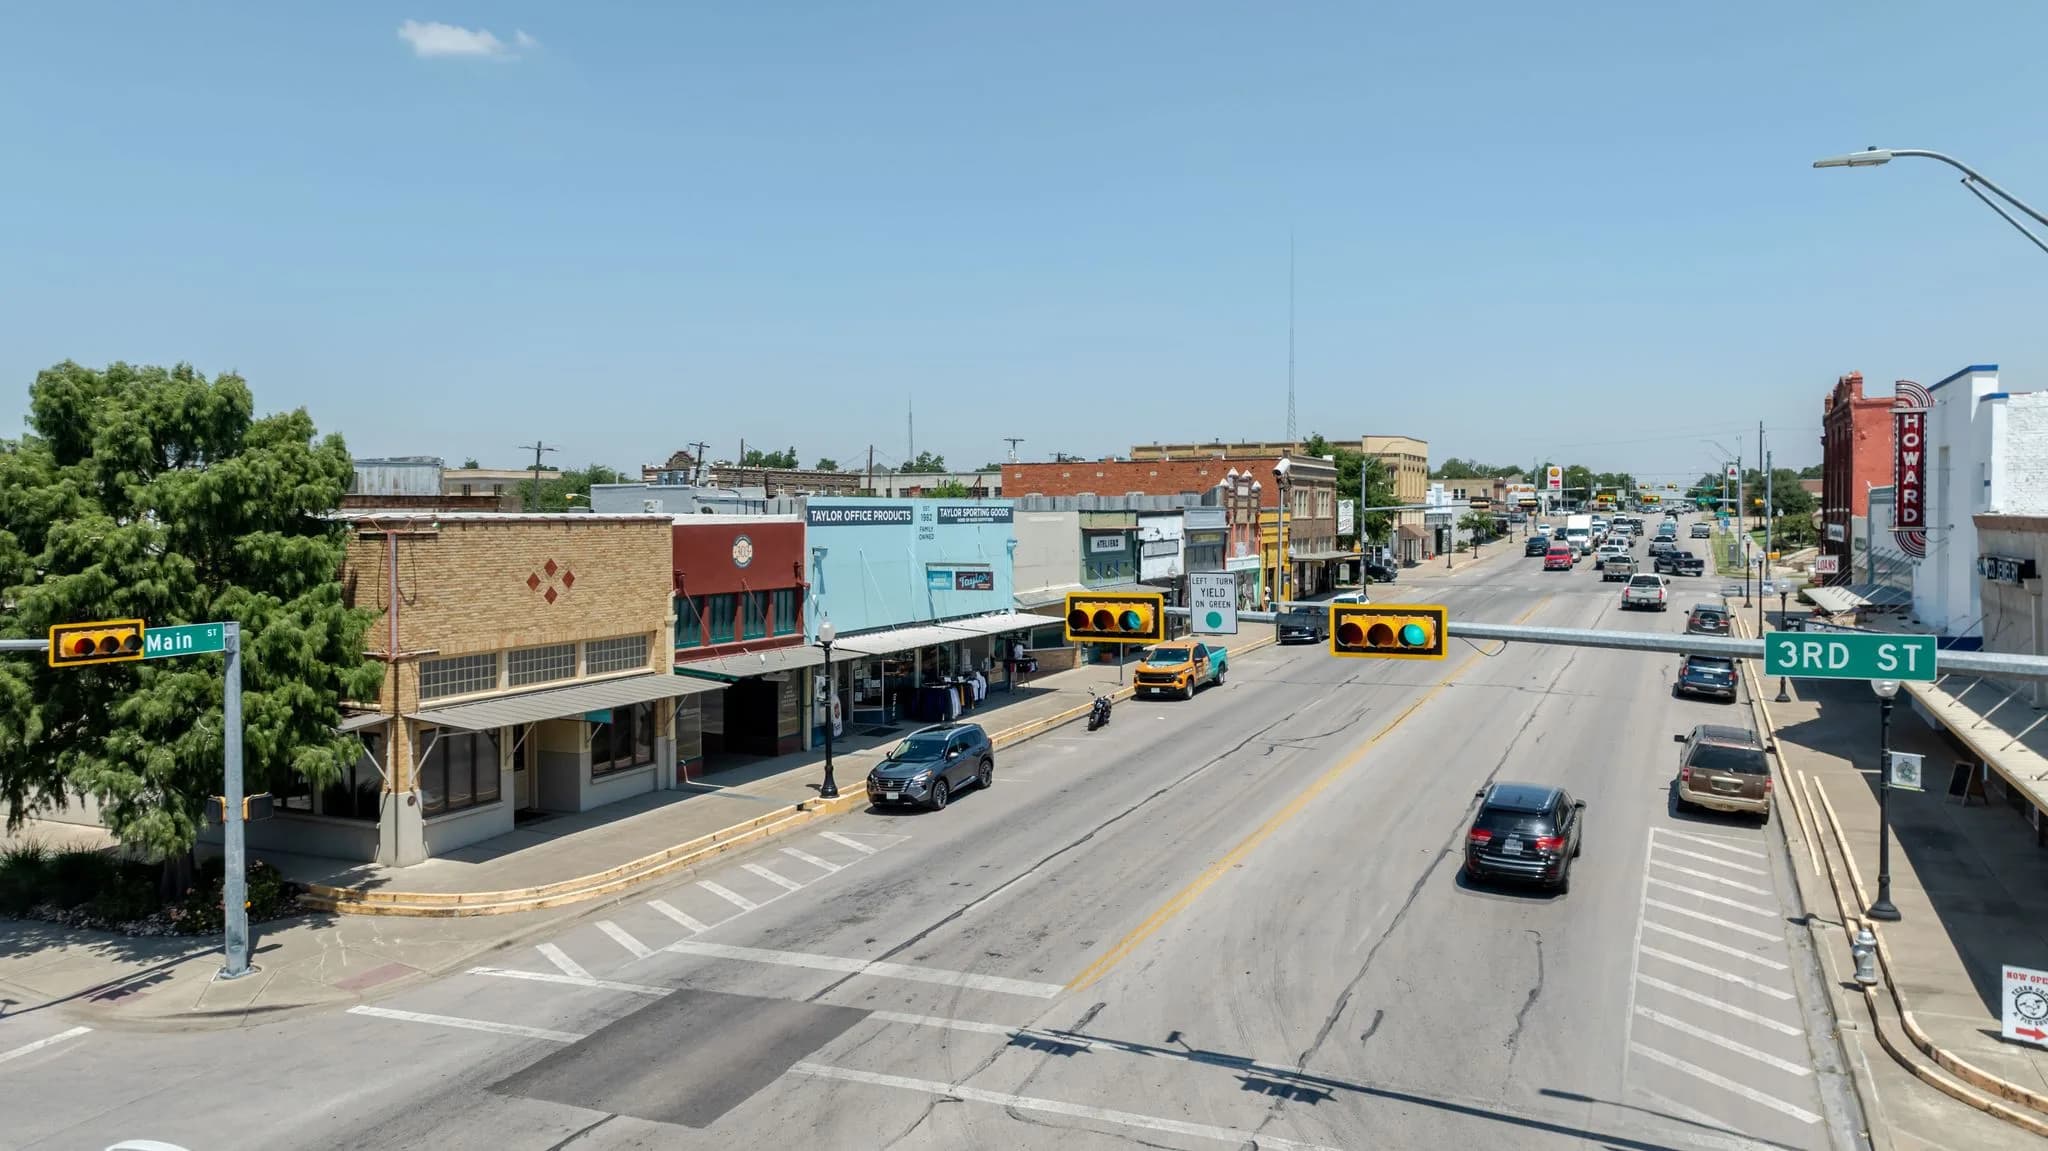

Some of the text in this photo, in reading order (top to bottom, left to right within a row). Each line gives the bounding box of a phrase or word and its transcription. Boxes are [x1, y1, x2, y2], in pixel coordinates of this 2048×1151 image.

[1903, 414, 1920, 522] HOWARD
[811, 510, 911, 521] TAYLOR OFFICE PRODUCTS
[940, 508, 1009, 517] TAYLOR SPORTING GOODS
[1817, 560, 1836, 571] LOANS
[1216, 577, 1233, 585] TURN
[1201, 588, 1225, 597] YIELD
[147, 629, 217, 653] Main ST
[1778, 641, 1922, 672] 3RD ST
[2007, 971, 2048, 984] NOW OPE
